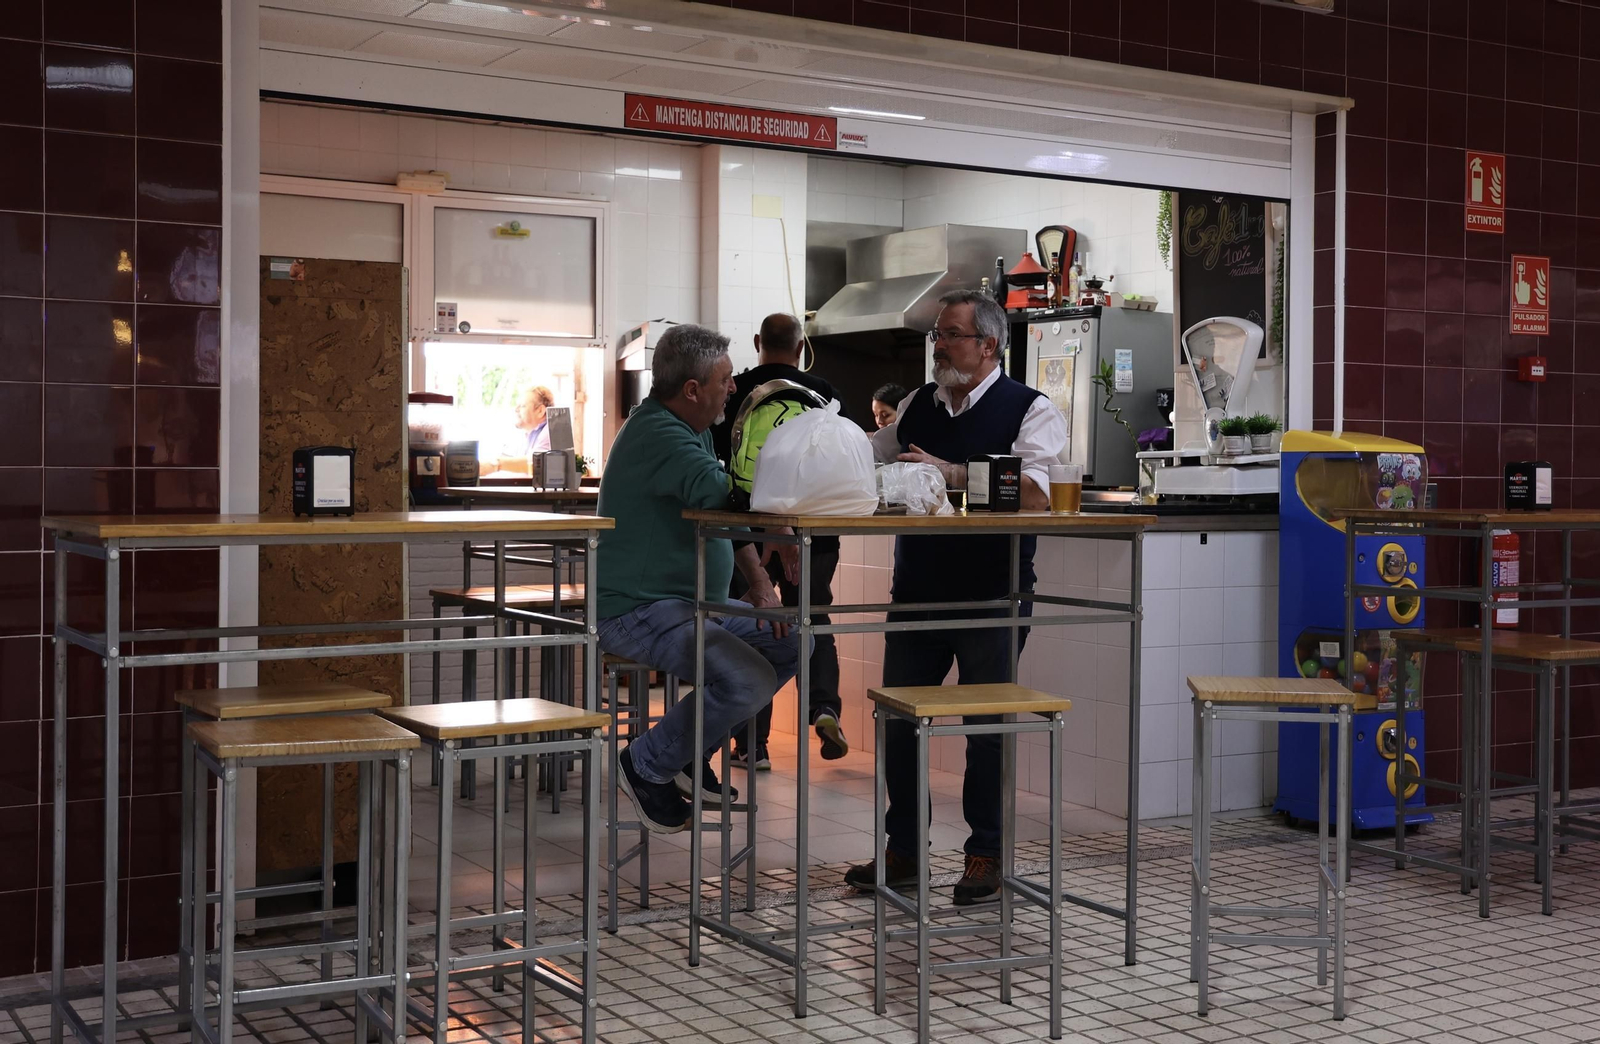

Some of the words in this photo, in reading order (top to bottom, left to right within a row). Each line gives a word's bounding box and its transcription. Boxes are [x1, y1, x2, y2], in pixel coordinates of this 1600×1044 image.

[655, 104, 703, 129] MANTENGA
[705, 110, 749, 134] DISTANCIA
[750, 115, 762, 135] DE
[763, 117, 809, 140] SEGURIDAD
[1467, 214, 1502, 227] EXTINTOR
[1222, 244, 1251, 266] 100%
[1514, 312, 1546, 322] PULSADOR
[1513, 323, 1521, 331] DE
[1522, 323, 1546, 332] ALARMA
